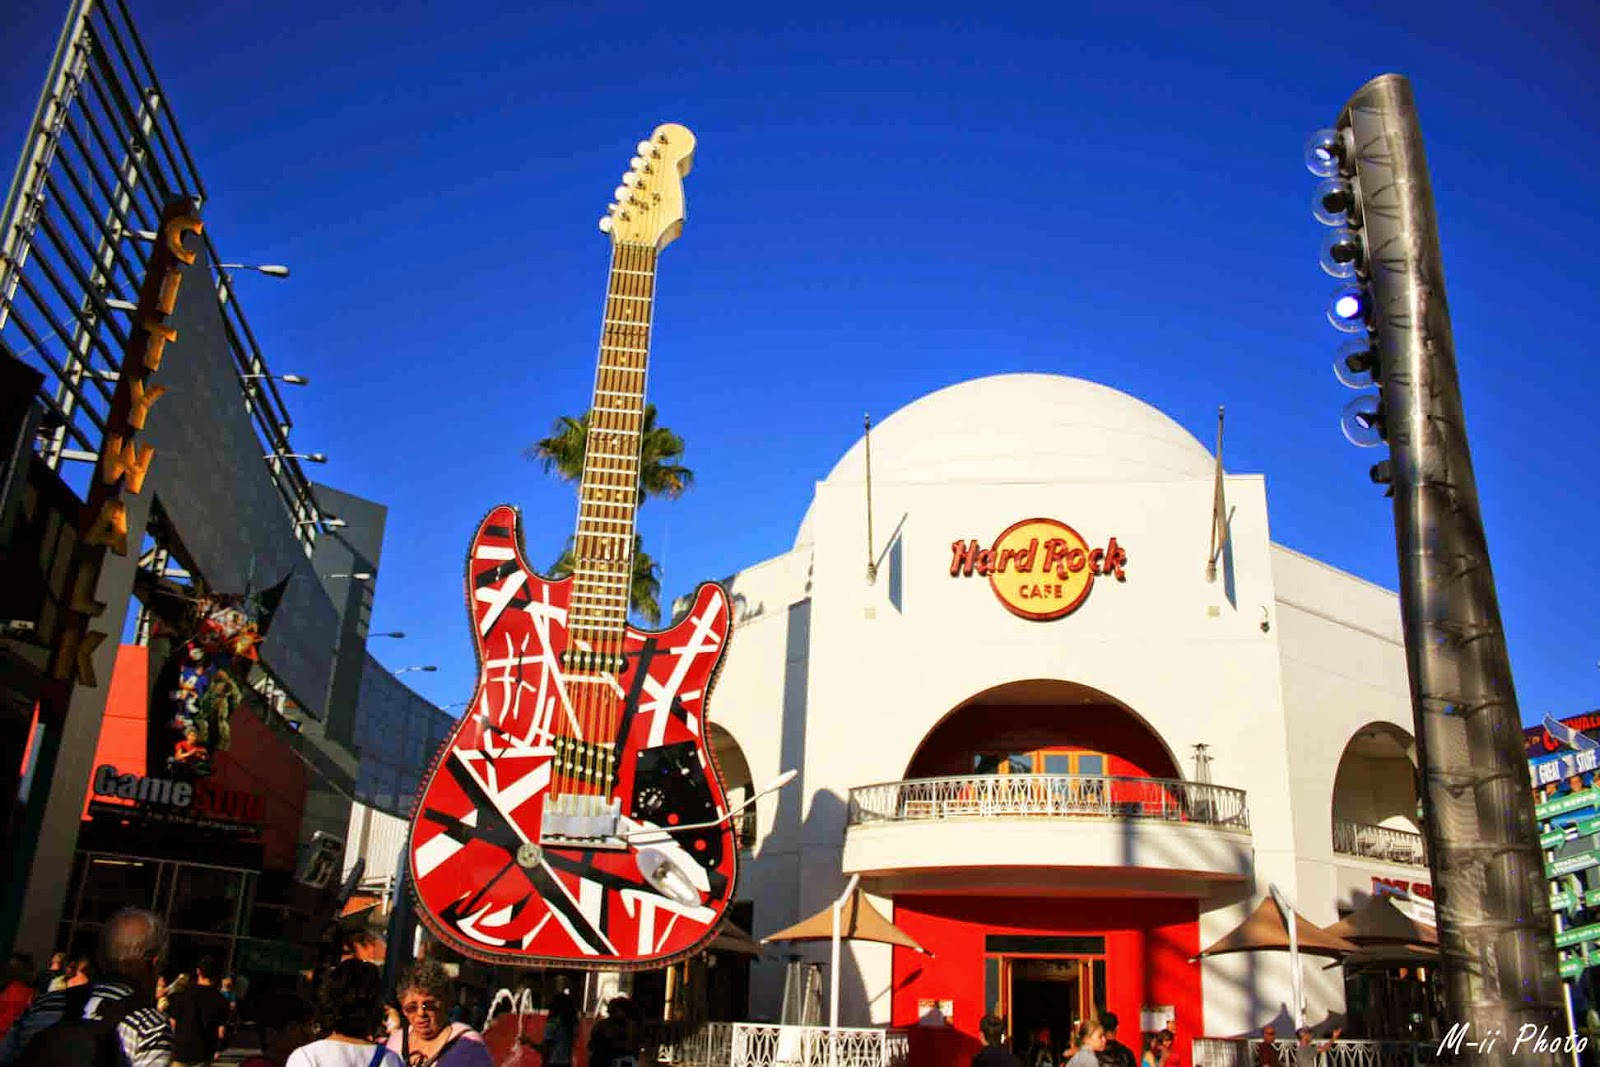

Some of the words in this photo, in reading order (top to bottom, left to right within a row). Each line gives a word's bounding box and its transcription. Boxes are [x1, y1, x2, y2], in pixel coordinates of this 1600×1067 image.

[53, 214, 204, 688] CITYWALK
[950, 539, 1039, 577] Hard
[1043, 537, 1128, 582] Rock
[1019, 584, 1063, 599] CAFE
